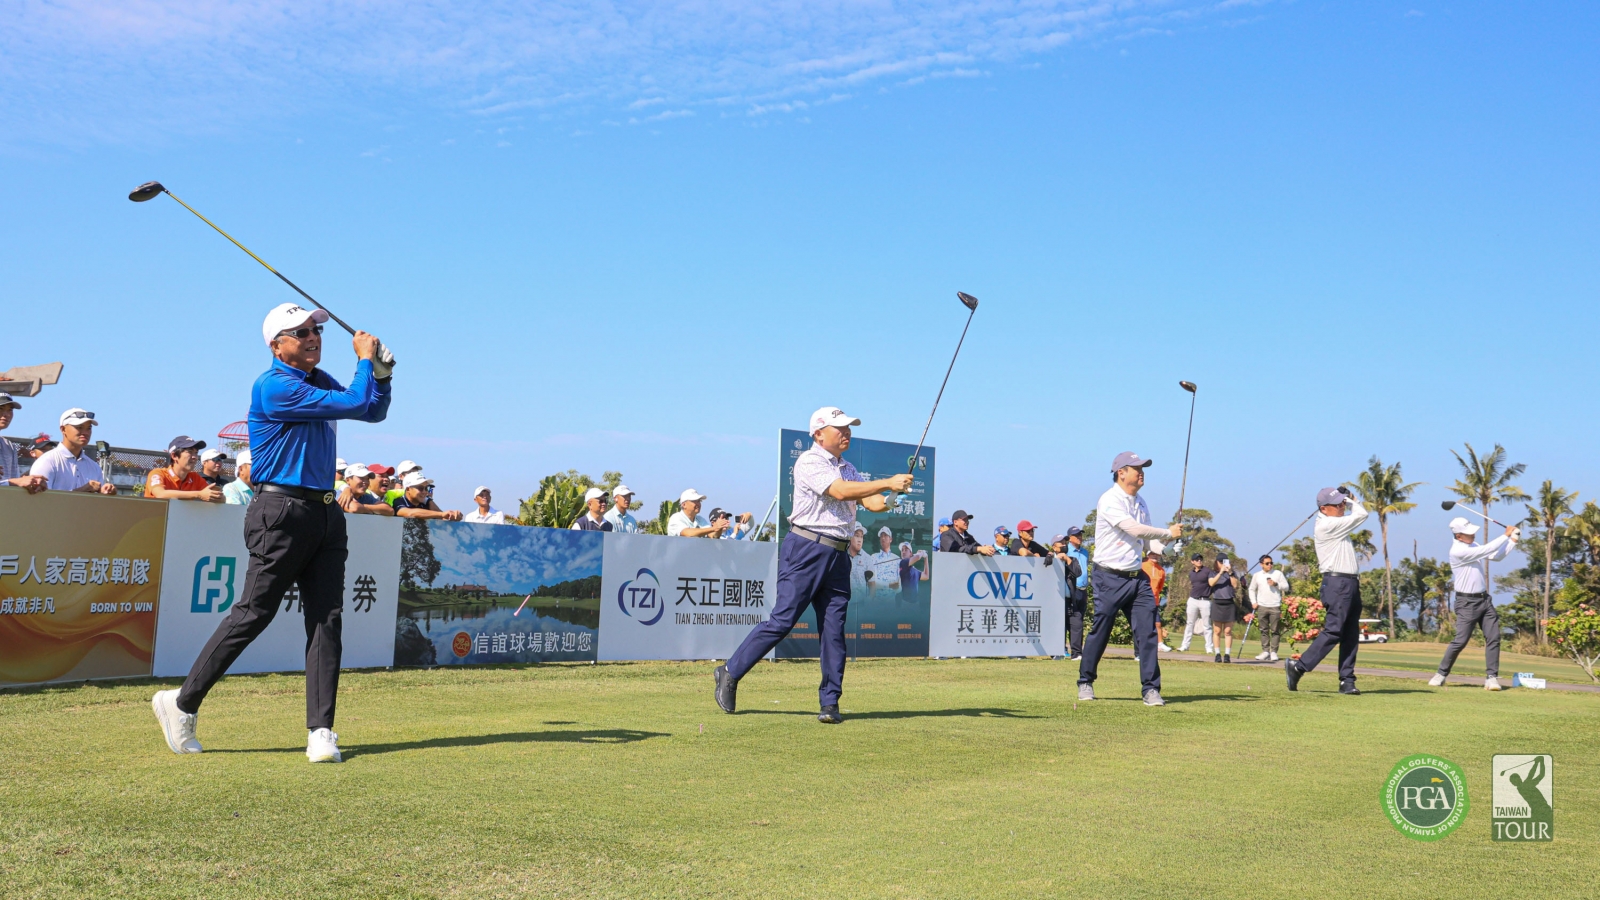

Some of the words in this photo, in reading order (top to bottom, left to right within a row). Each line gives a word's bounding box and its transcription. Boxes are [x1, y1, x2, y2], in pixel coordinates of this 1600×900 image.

[0, 554, 151, 585] 戶人家高球戰隊
[675, 577, 765, 608] 天正國際
[966, 570, 1034, 600] CWE
[90, 602, 118, 614] BORN
[120, 602, 132, 613] TO
[134, 602, 154, 613] WIN
[628, 587, 656, 609] TZI
[675, 613, 691, 625] TIAN
[692, 613, 714, 625] ZHENG
[957, 608, 1041, 634] 長華集團
[473, 632, 592, 654] 信誼球場歡迎您
